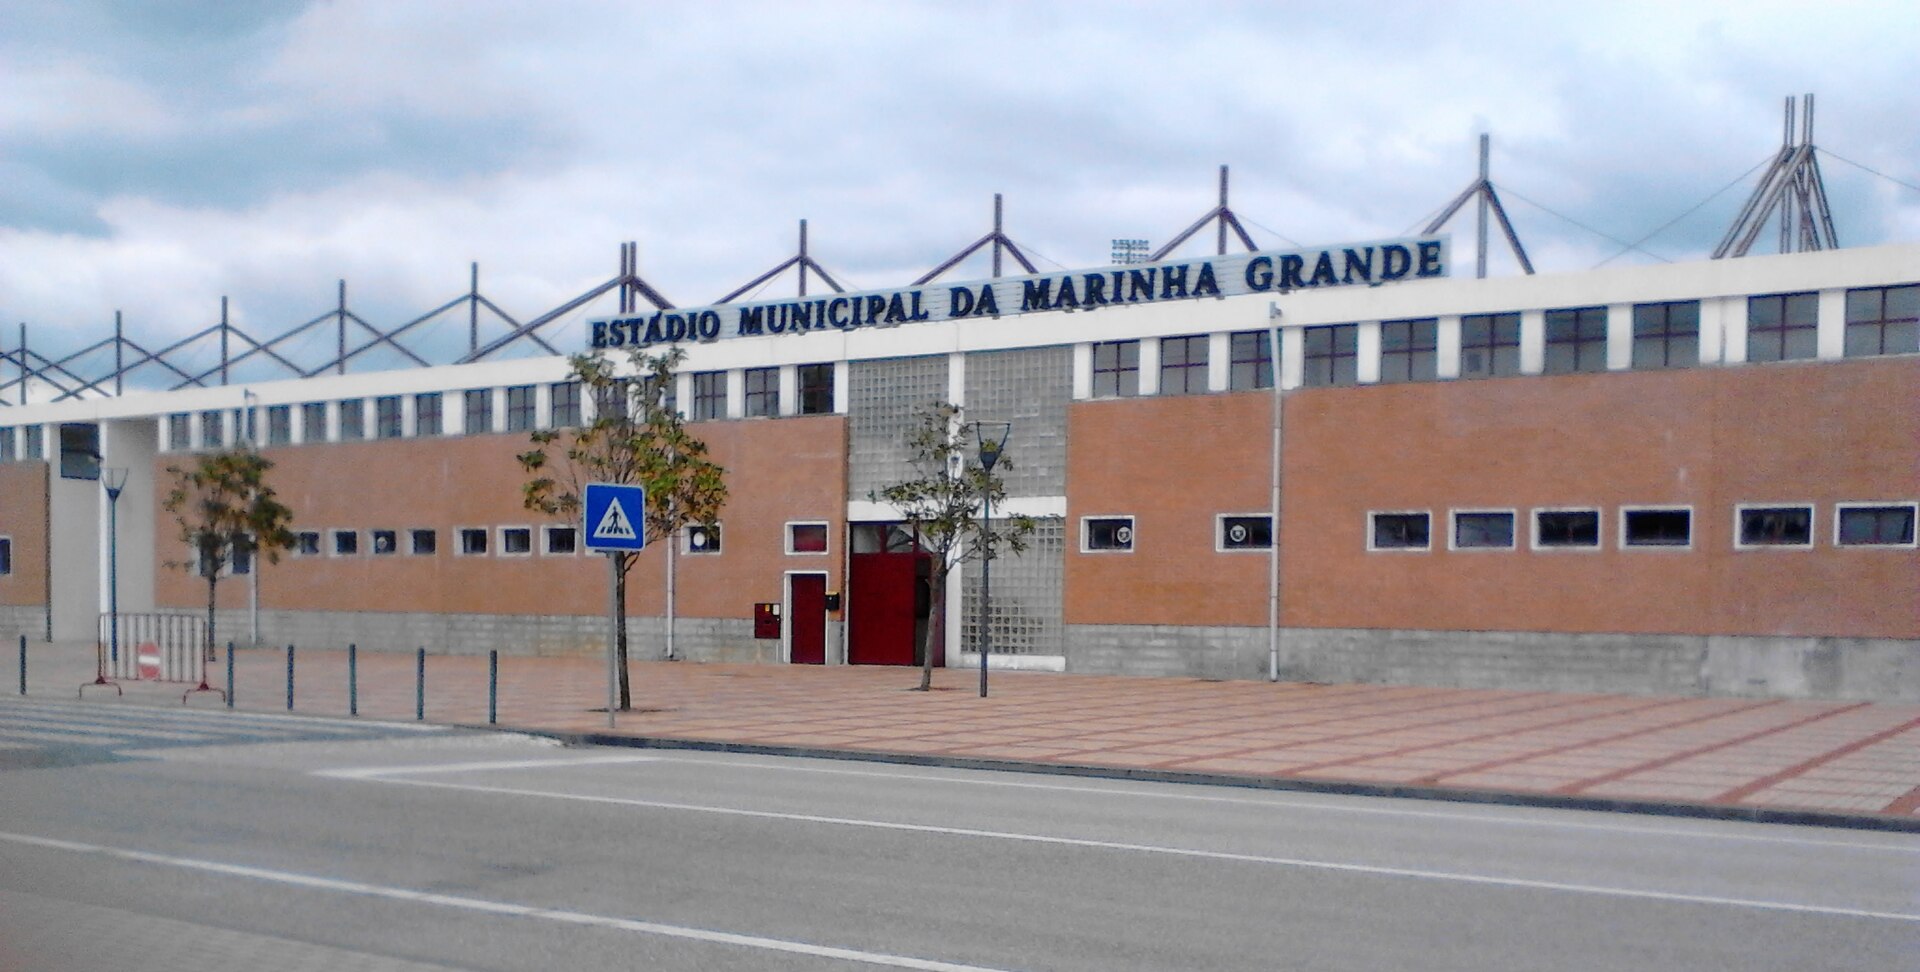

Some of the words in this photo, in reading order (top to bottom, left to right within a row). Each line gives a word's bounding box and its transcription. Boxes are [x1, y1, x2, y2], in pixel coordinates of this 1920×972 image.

[591, 310, 721, 348] ESTÁDIO
[738, 290, 929, 336] MUNICIPAL
[949, 284, 999, 317] DA
[1021, 262, 1220, 311] MARINHA
[1245, 241, 1442, 292] GRANDE
